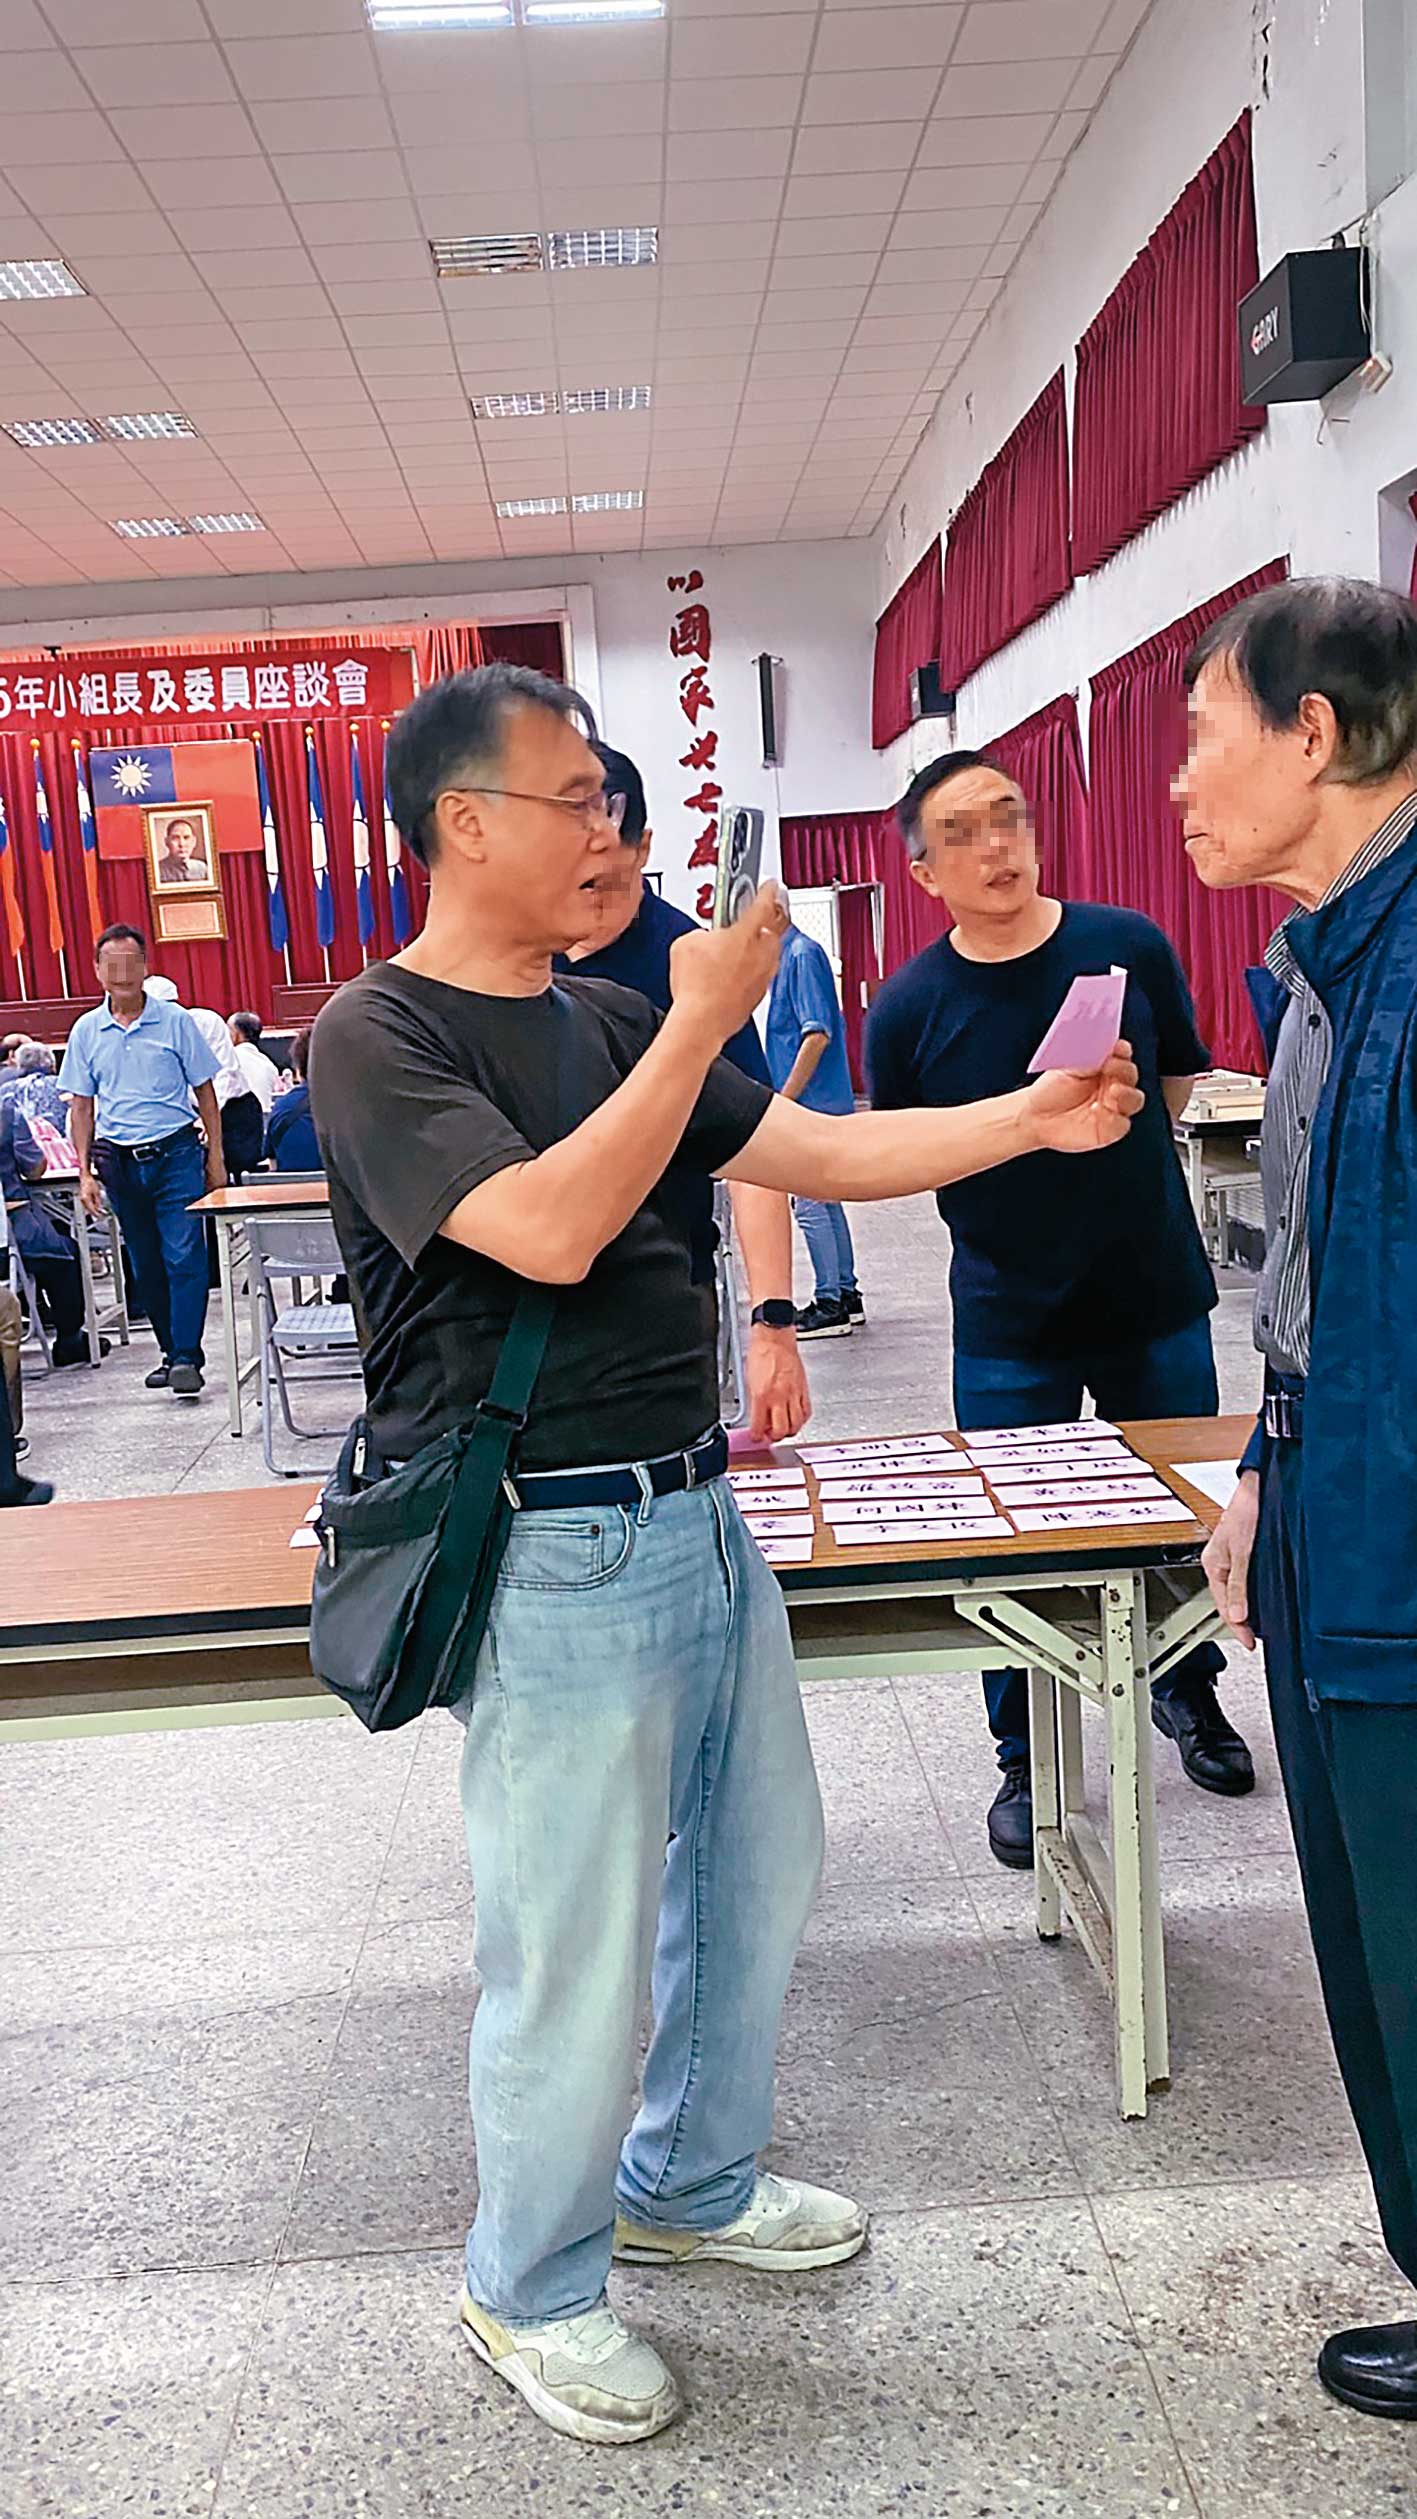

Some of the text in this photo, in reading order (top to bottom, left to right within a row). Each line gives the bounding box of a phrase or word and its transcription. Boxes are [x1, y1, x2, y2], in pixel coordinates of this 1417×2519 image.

[0, 658, 370, 719] 5年小組長及委員座談會
